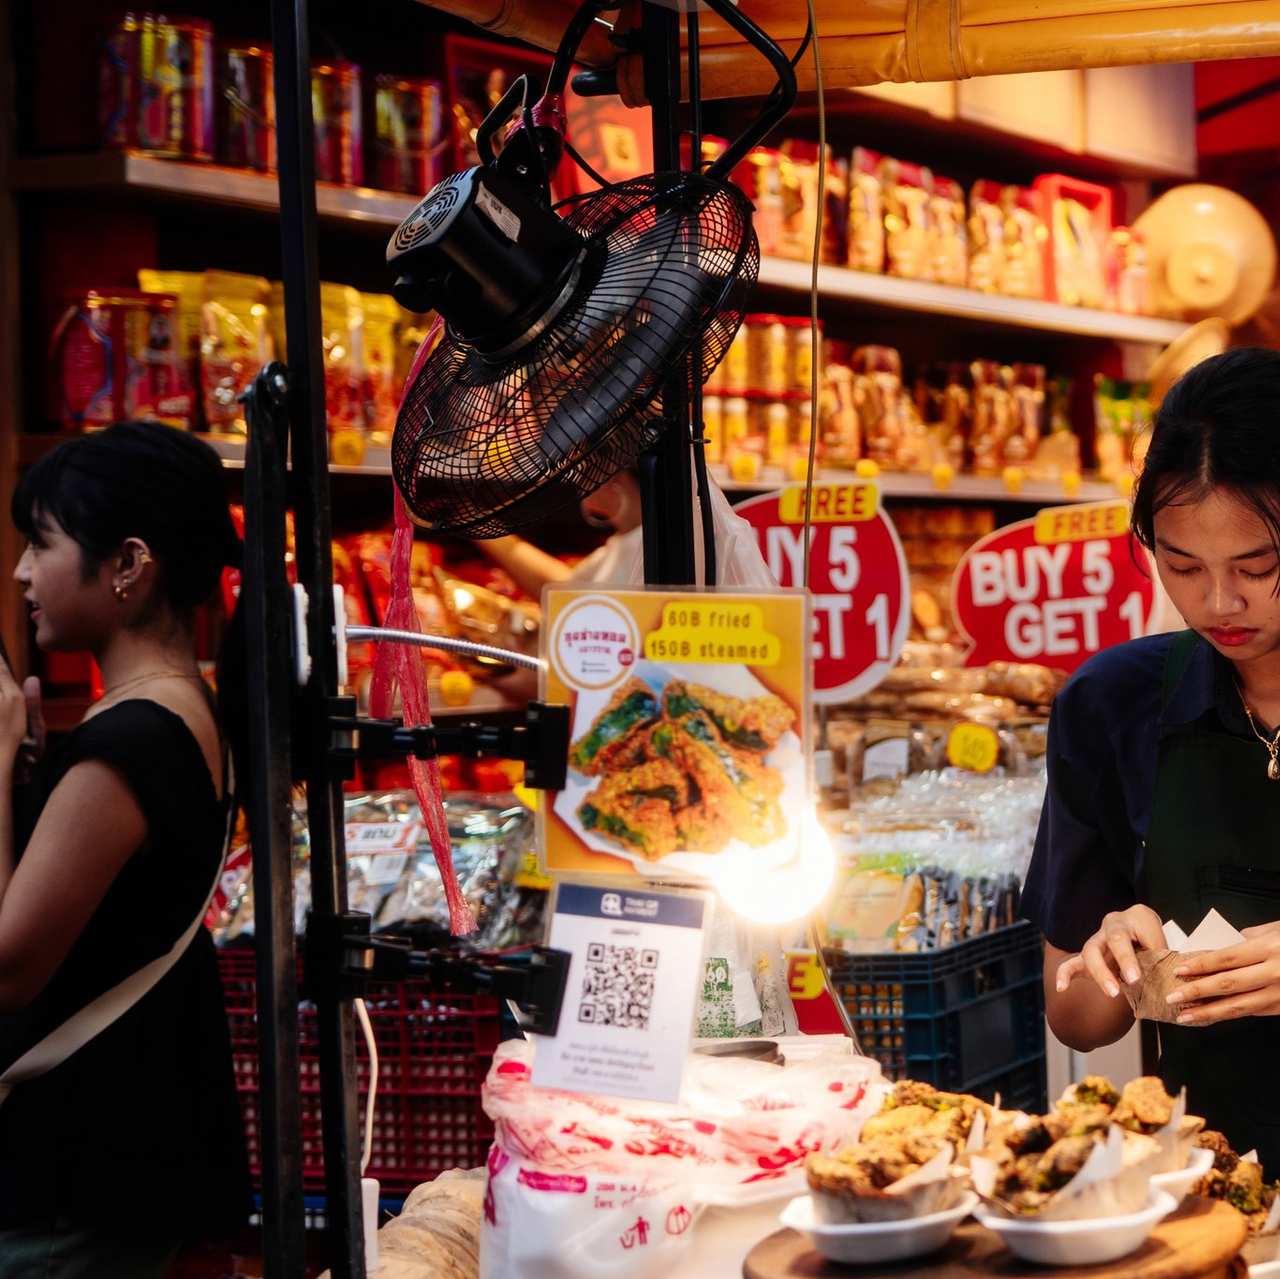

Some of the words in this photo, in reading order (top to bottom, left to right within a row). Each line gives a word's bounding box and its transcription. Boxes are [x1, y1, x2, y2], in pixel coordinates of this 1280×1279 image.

[798, 486, 868, 517] FREE
[1051, 505, 1114, 538] FREE
[828, 527, 861, 592] 5
[969, 543, 1071, 607] BUY
[1083, 540, 1114, 596] 5
[709, 610, 751, 628] fried
[866, 594, 889, 662] 1
[1005, 595, 1108, 659] GET
[1119, 590, 1143, 643] 1
[651, 640, 691, 657] 150B
[700, 642, 768, 659] steamed
